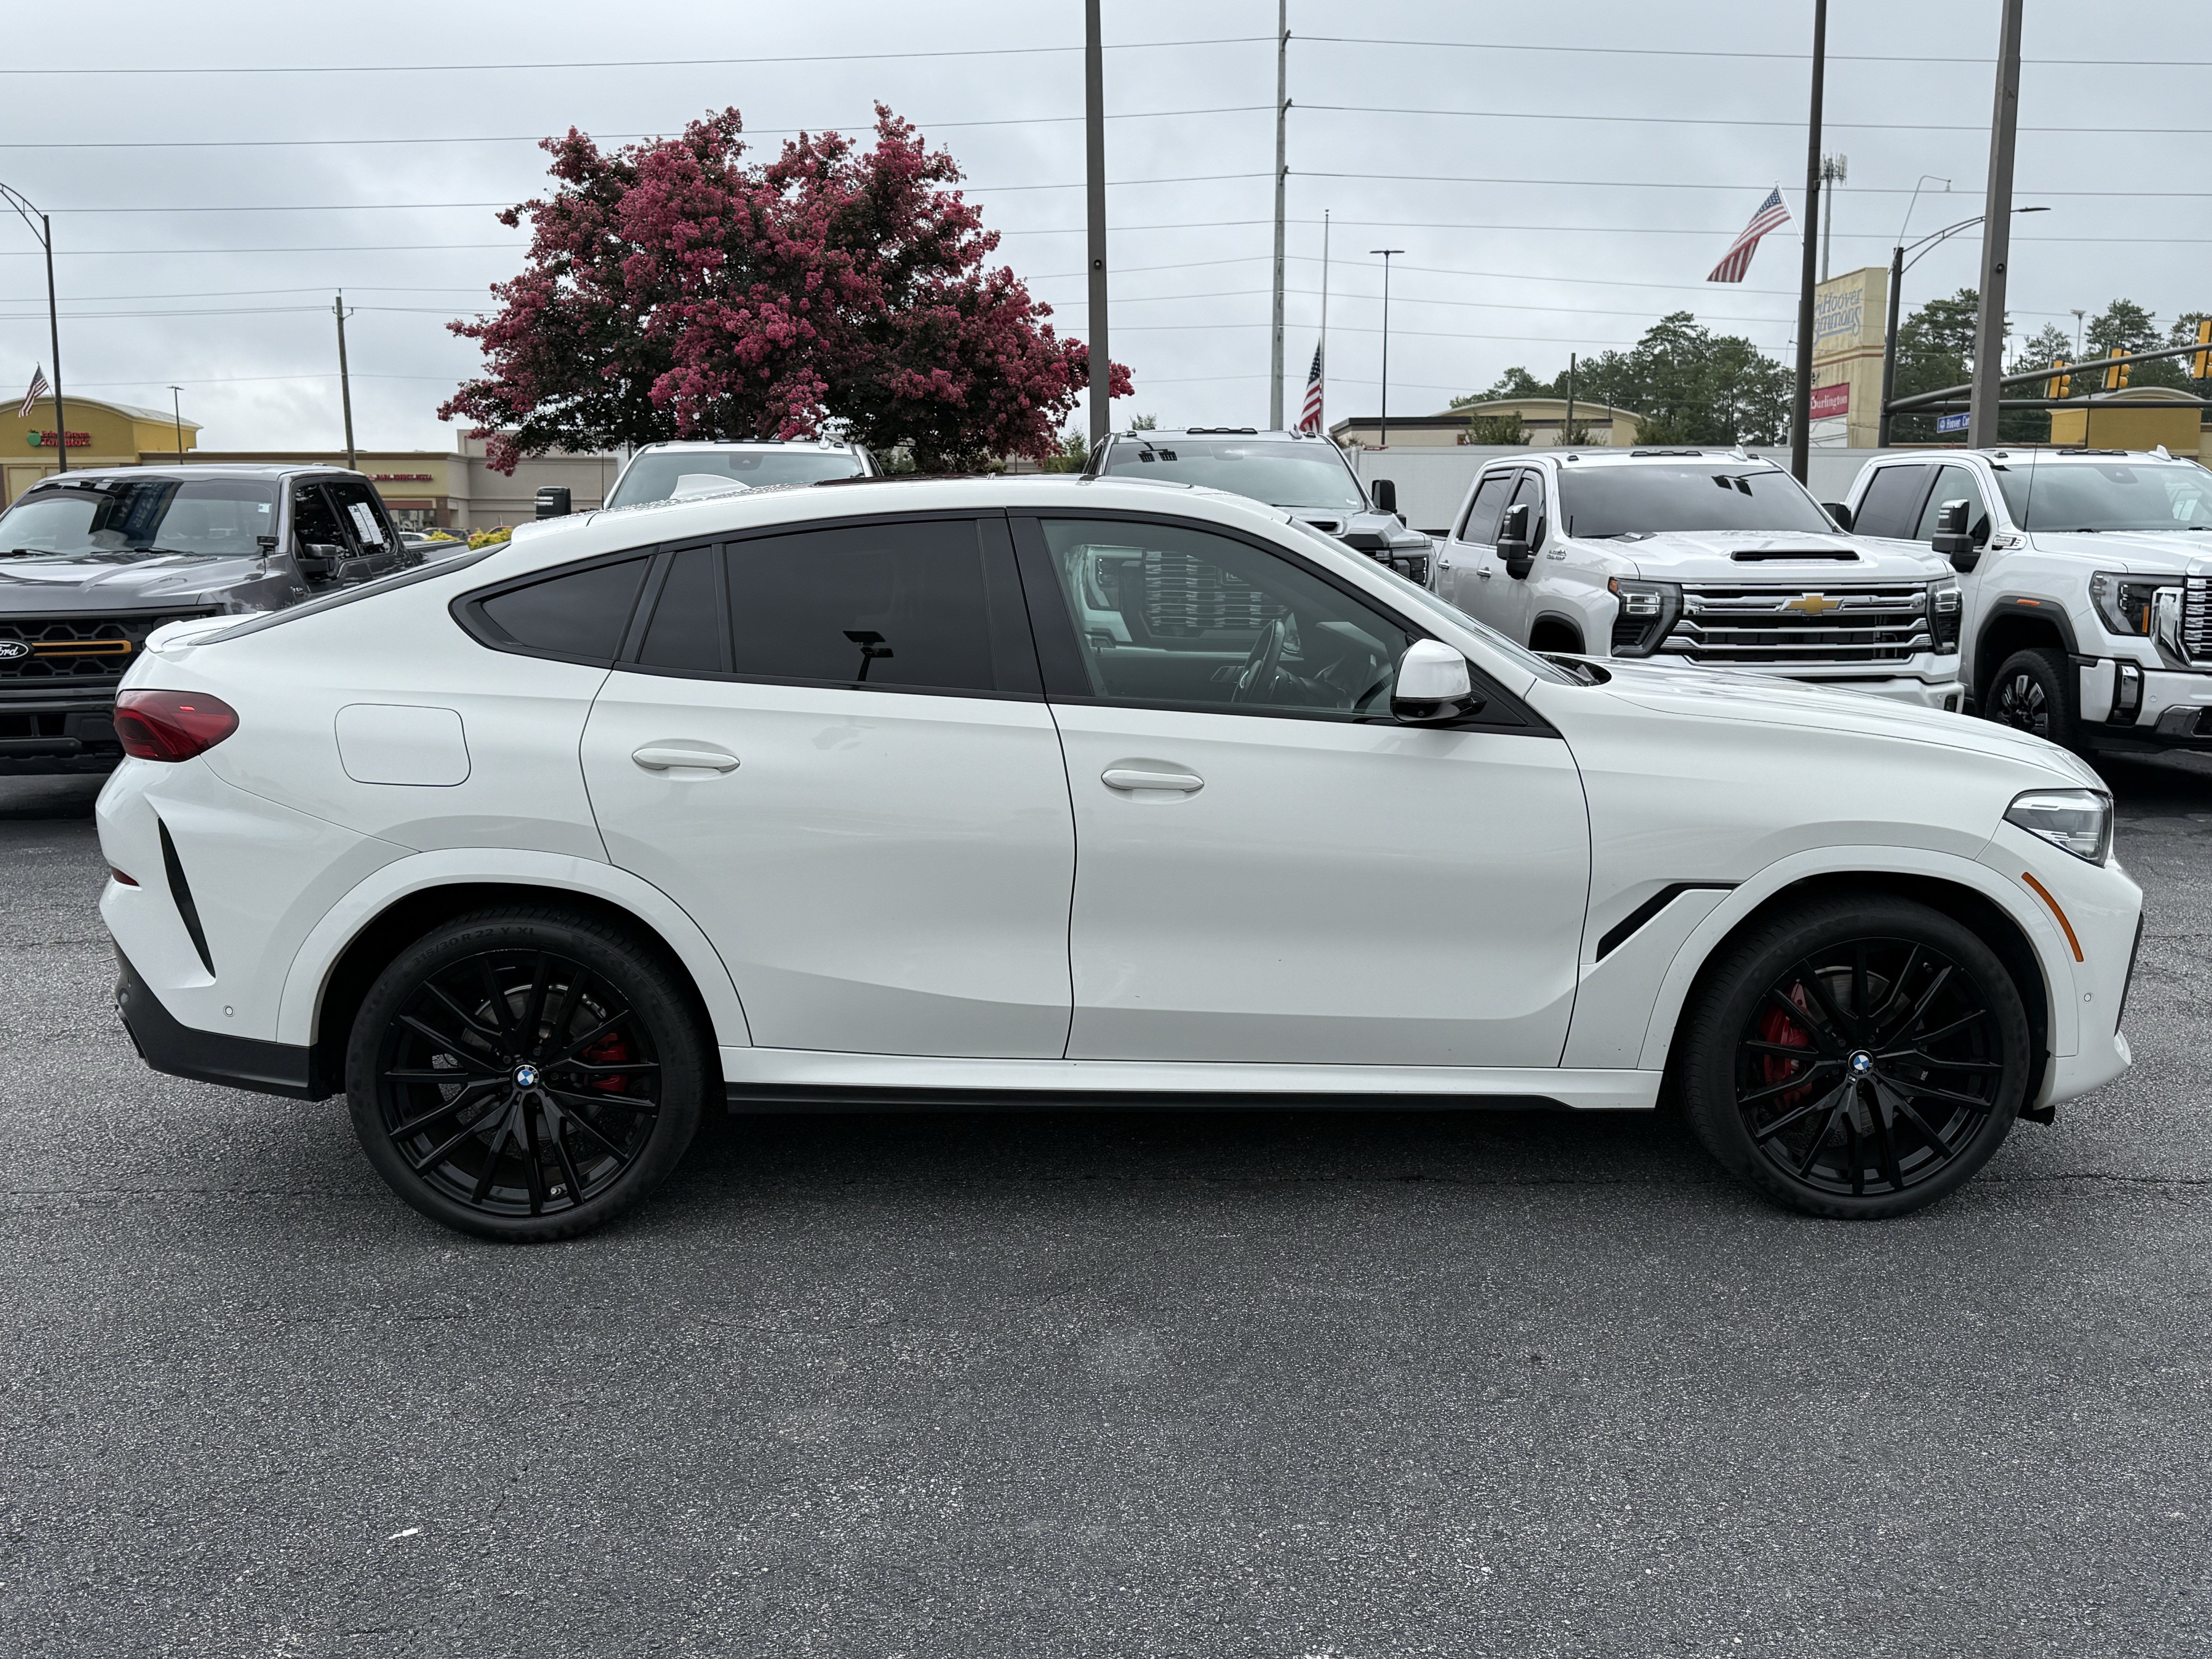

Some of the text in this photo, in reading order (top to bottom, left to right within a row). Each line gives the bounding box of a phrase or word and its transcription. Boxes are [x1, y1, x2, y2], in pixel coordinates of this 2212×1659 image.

[1821, 288, 1863, 314] Hoover
[1813, 306, 1863, 346] ommons
[412, 927, 538, 967] 315/30 R 22 Y XL
